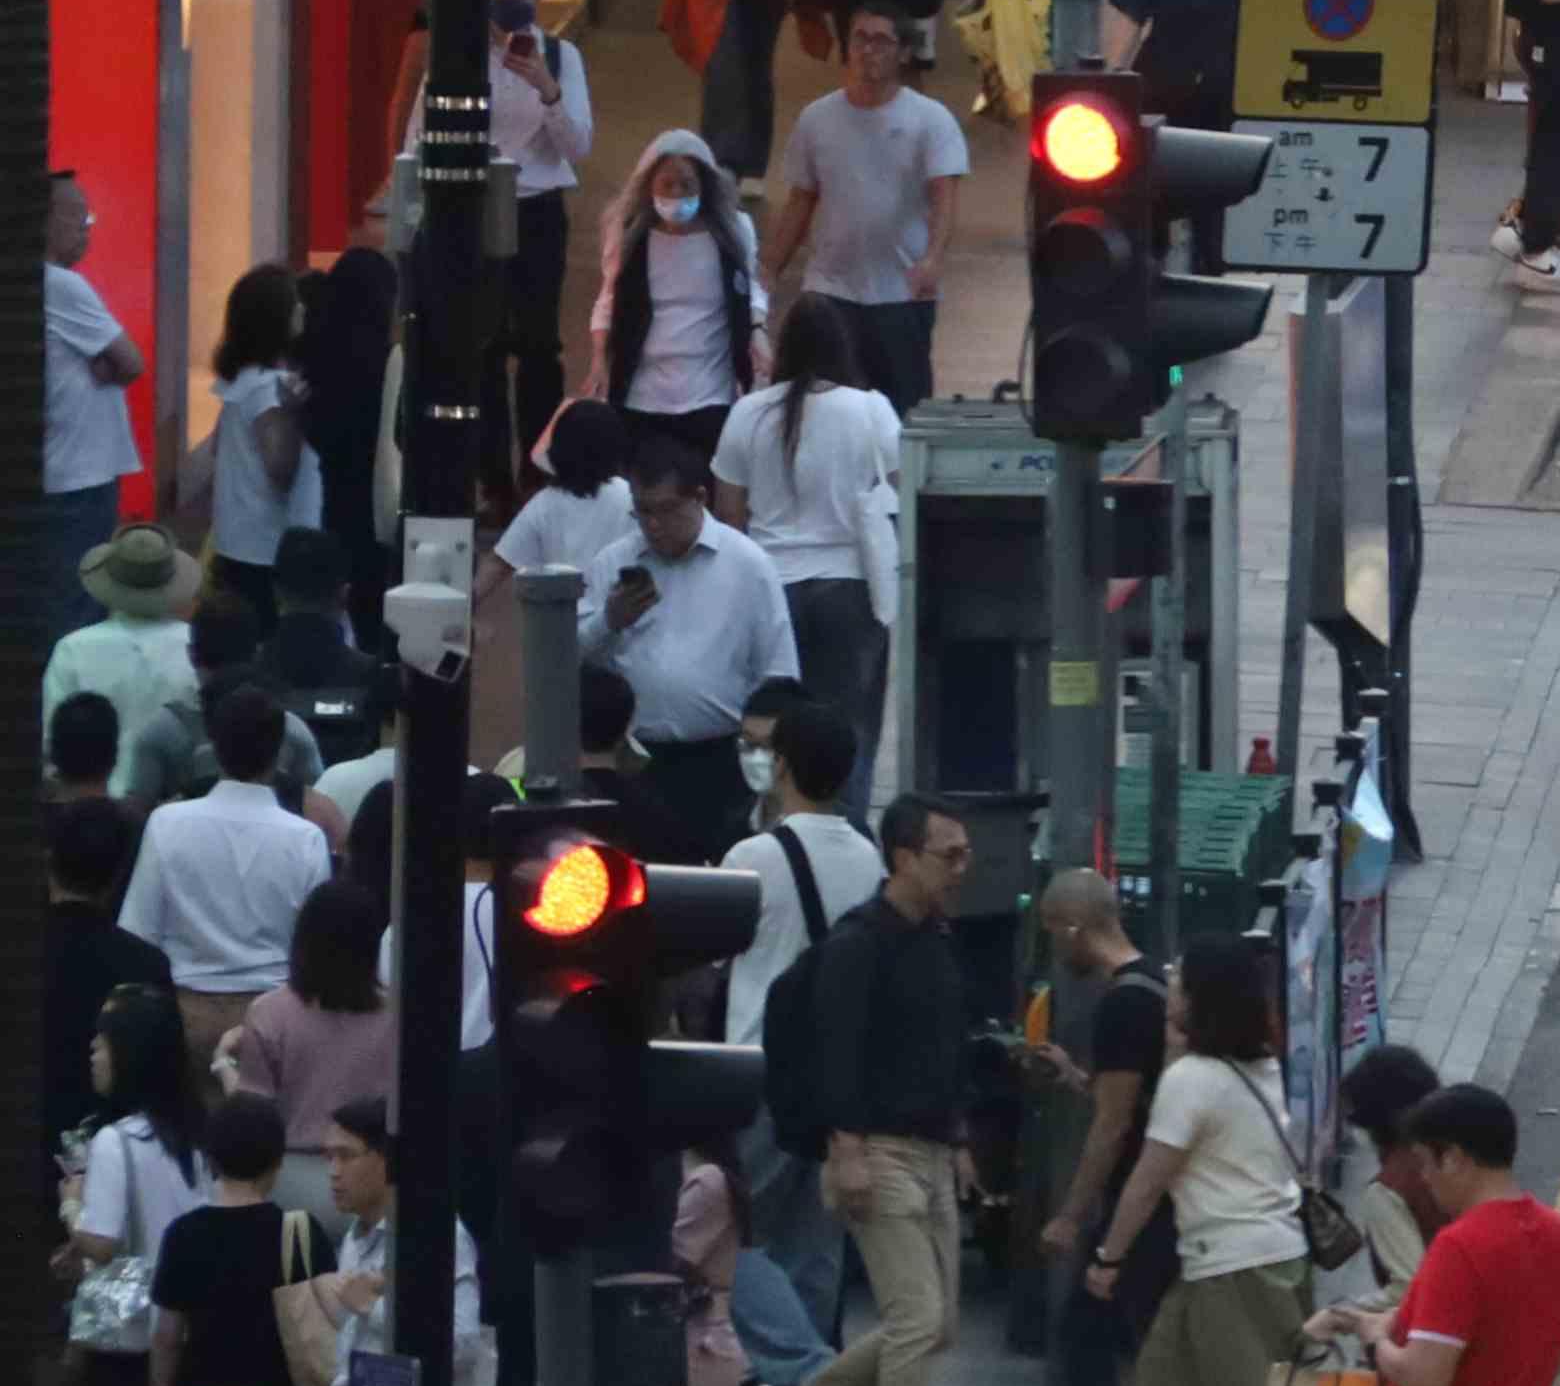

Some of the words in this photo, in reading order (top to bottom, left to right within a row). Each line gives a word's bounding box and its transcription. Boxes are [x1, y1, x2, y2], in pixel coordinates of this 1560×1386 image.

[1278, 129, 1314, 147] am
[1357, 136, 1390, 182] 7
[1273, 207, 1309, 228] pm
[1353, 214, 1386, 259] 7
